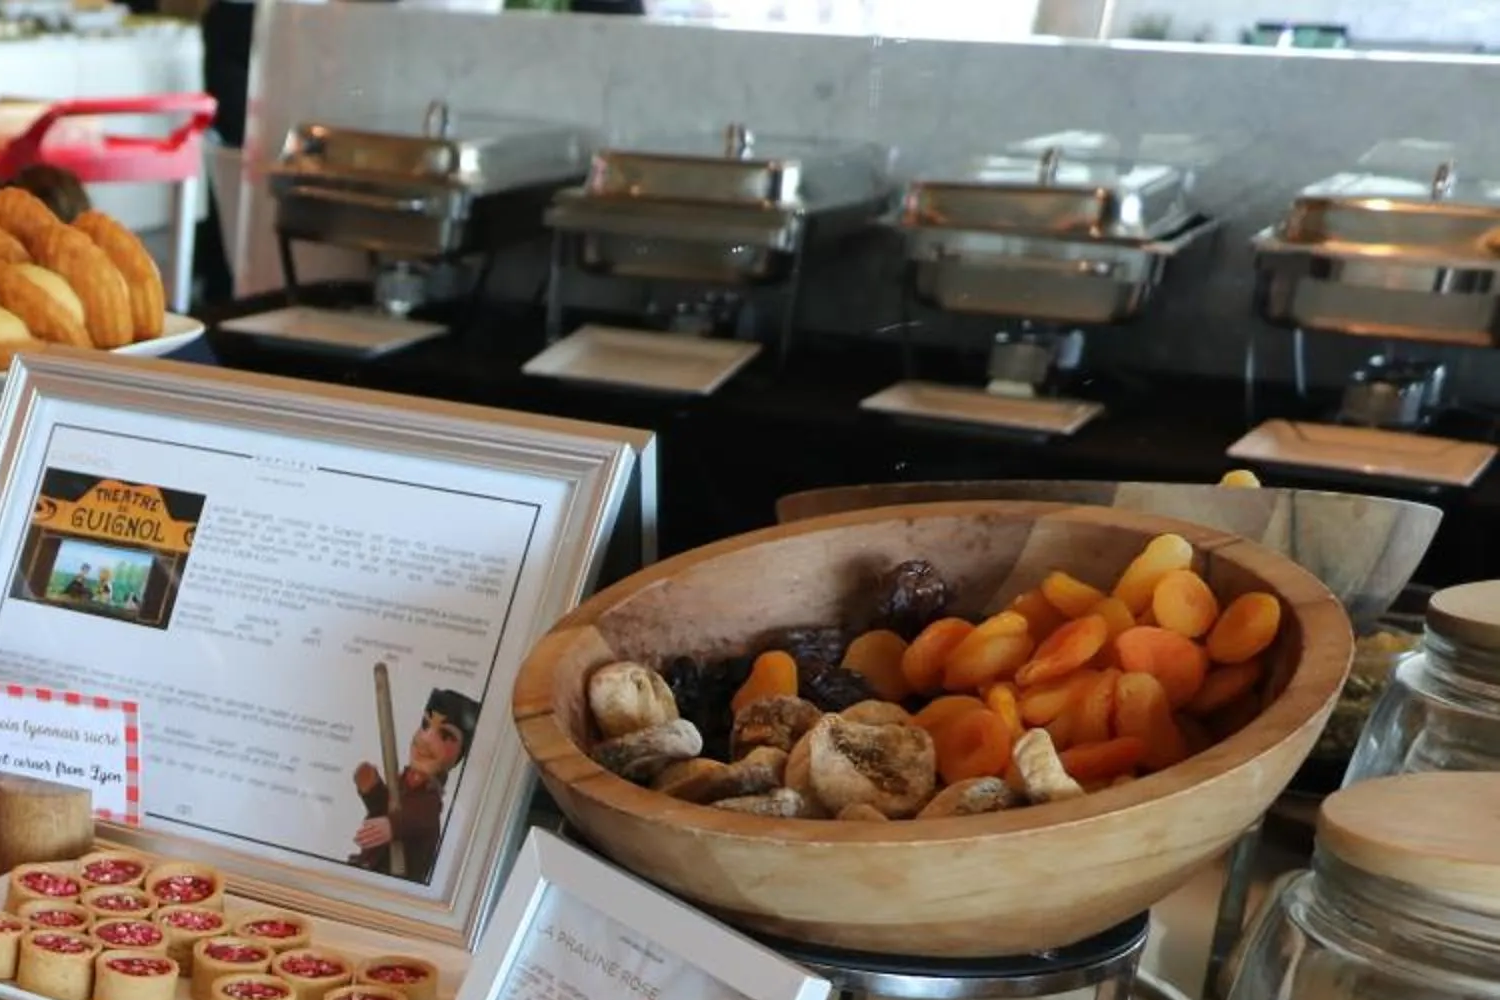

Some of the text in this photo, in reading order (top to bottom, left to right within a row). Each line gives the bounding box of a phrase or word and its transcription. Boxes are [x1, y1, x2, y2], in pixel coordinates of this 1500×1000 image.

[71, 511, 165, 542] GUIGNOL
[23, 719, 80, 740] lyonnais
[13, 756, 51, 773] corner
[55, 761, 85, 778] from
[90, 764, 123, 785] Lyon
[556, 929, 622, 978] PRALINE
